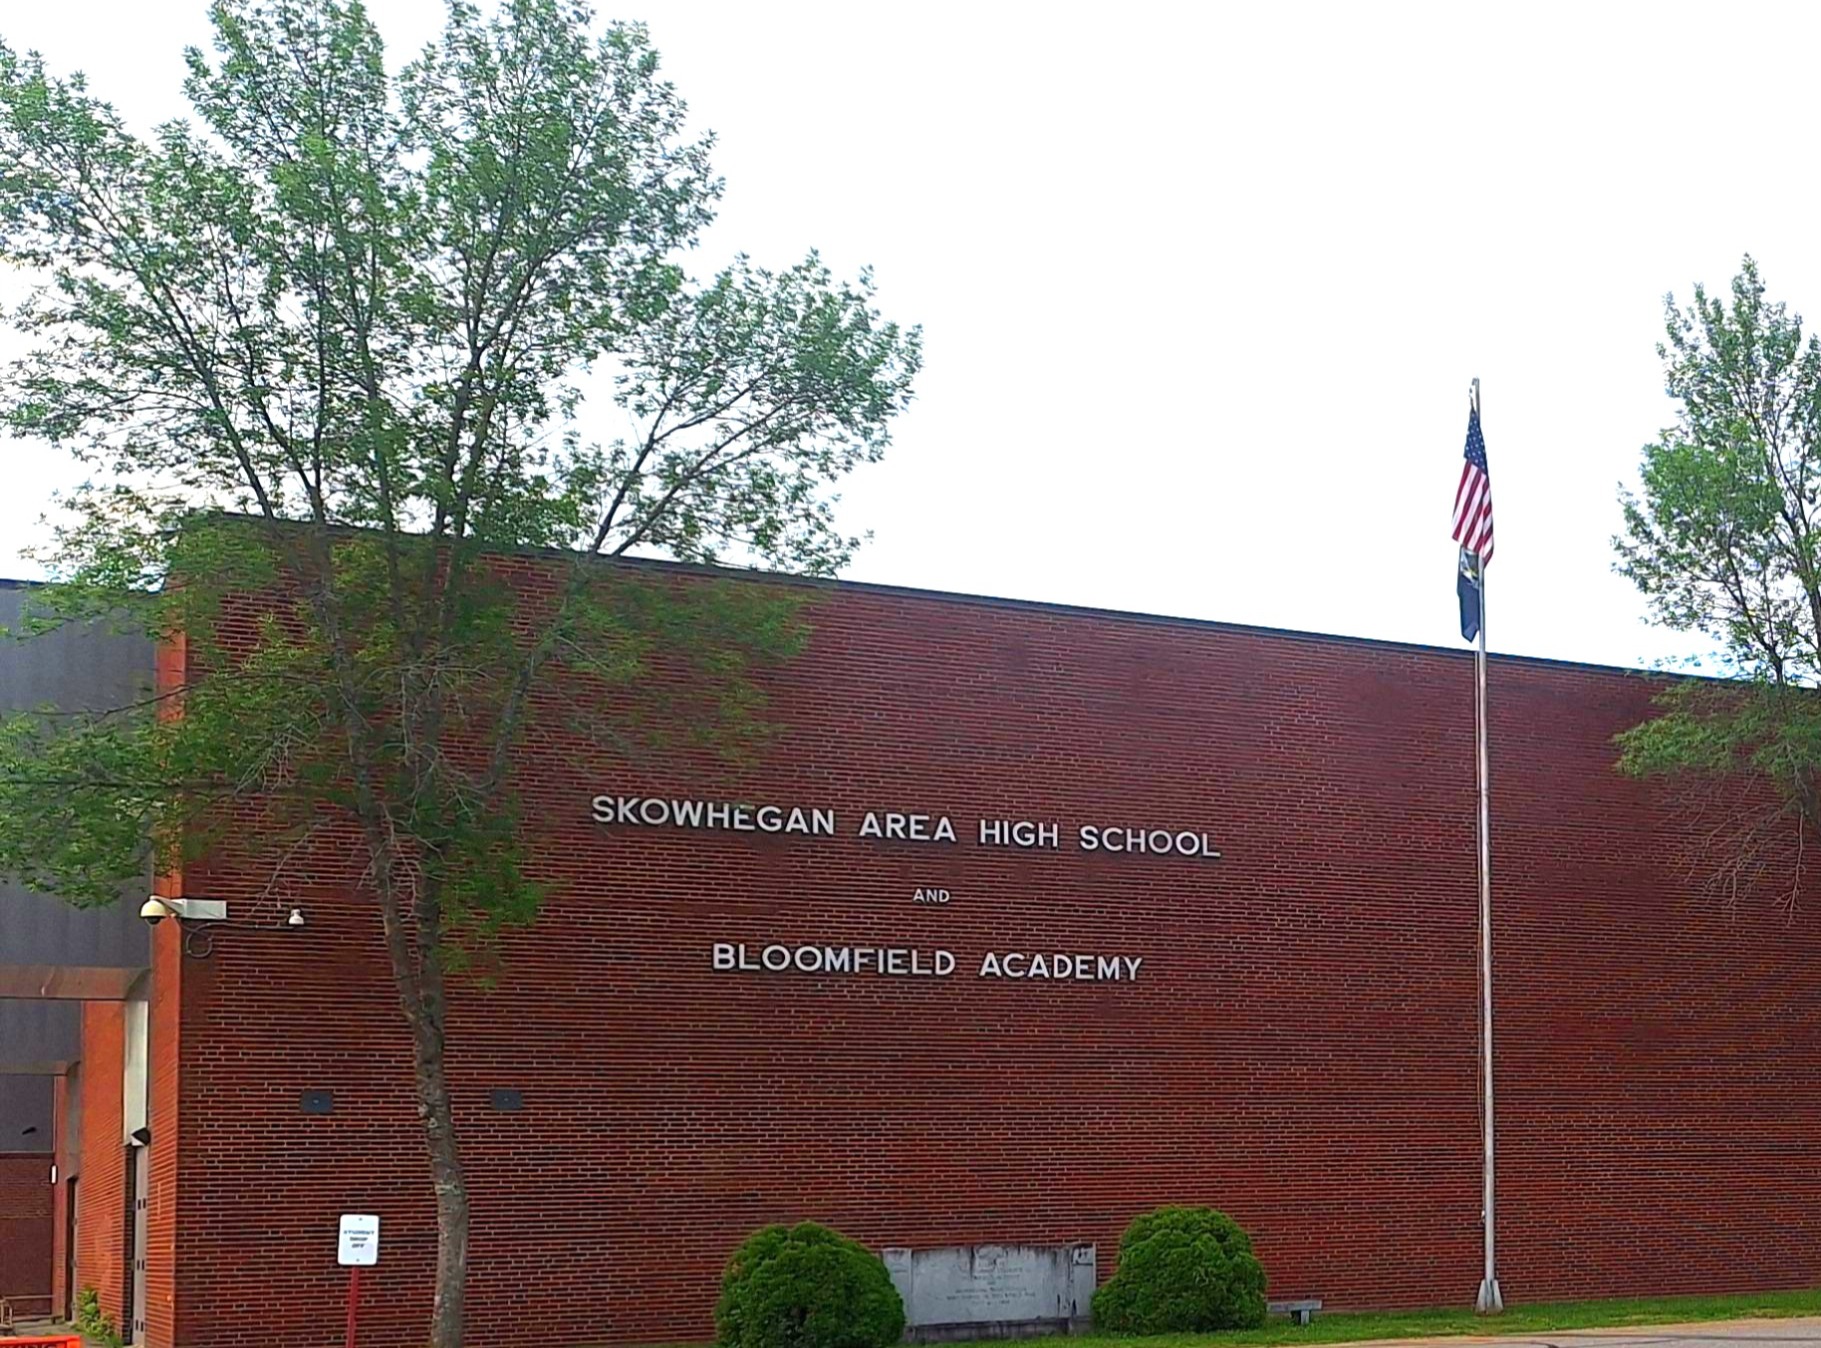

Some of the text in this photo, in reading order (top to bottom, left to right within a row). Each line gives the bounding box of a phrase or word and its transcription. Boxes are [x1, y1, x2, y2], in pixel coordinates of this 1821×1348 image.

[592, 795, 1221, 857] SKOWHEGAN AREA HIGH SCHOOL
[912, 887, 950, 903] AND
[712, 943, 1143, 981] BLOOMFIELD ACADEMY
